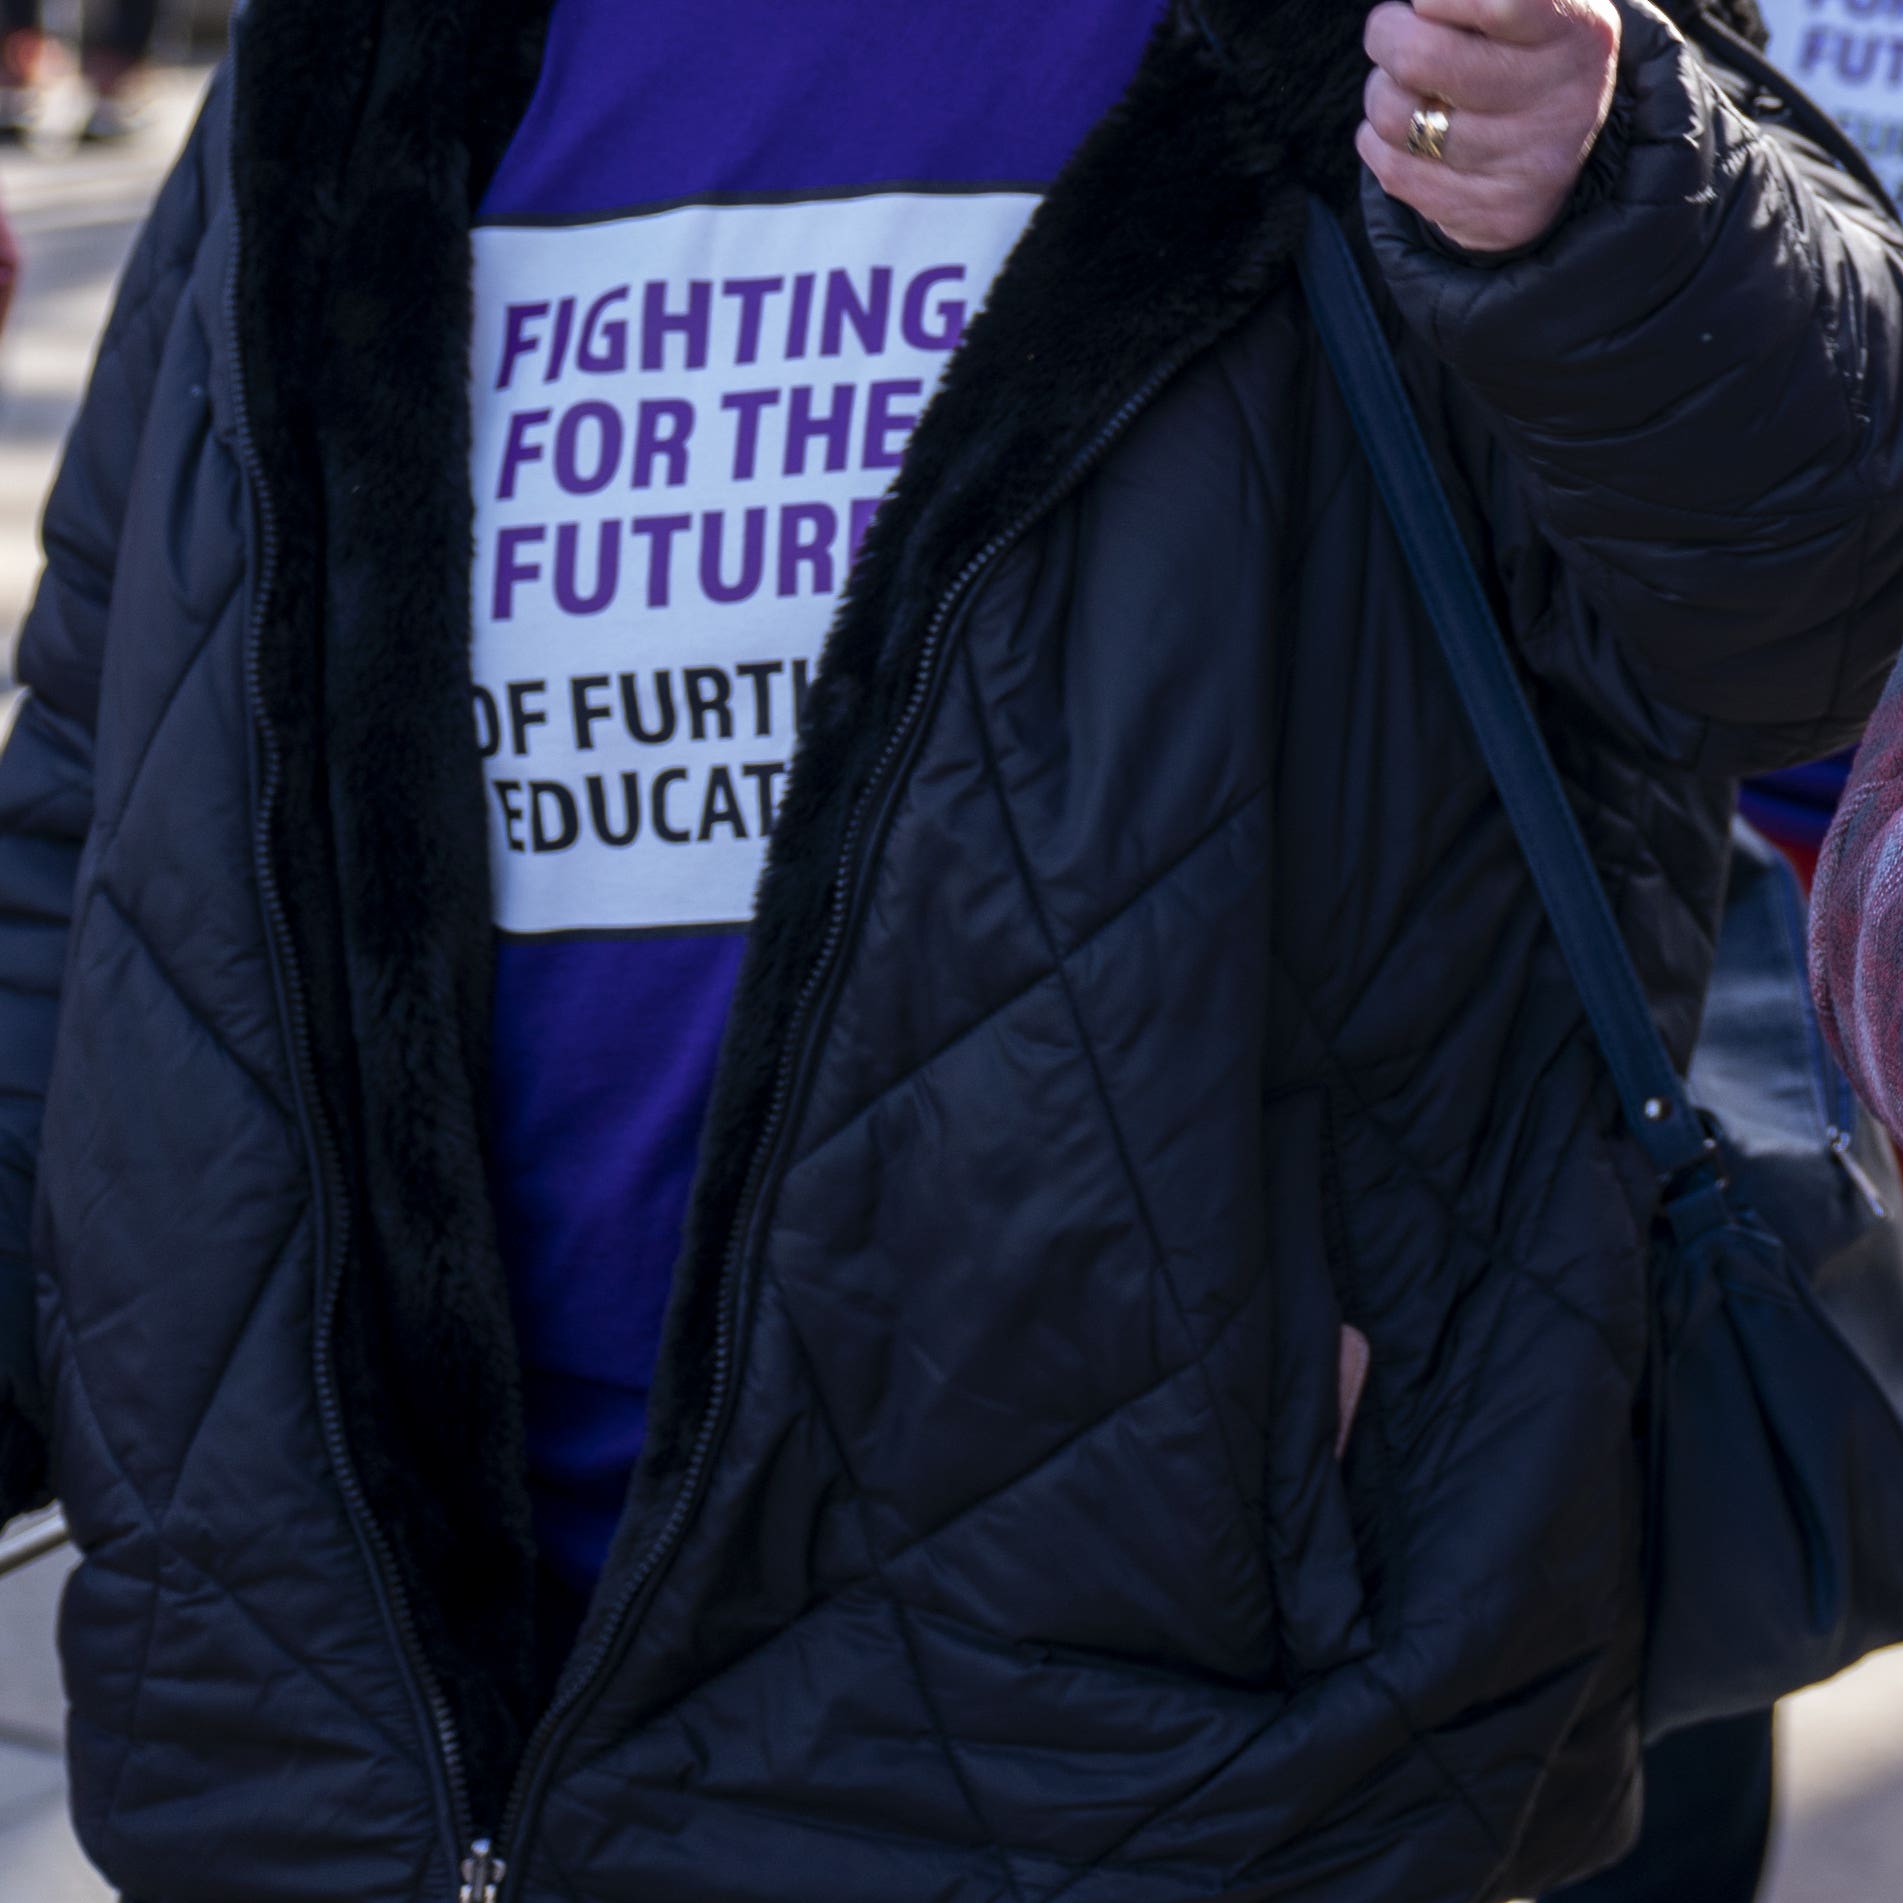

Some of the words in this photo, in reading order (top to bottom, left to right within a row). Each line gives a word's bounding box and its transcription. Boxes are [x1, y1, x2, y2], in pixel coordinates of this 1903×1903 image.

[495, 264, 968, 392] FIGHTING
[495, 398, 697, 501] FOR
[720, 377, 924, 482] THE
